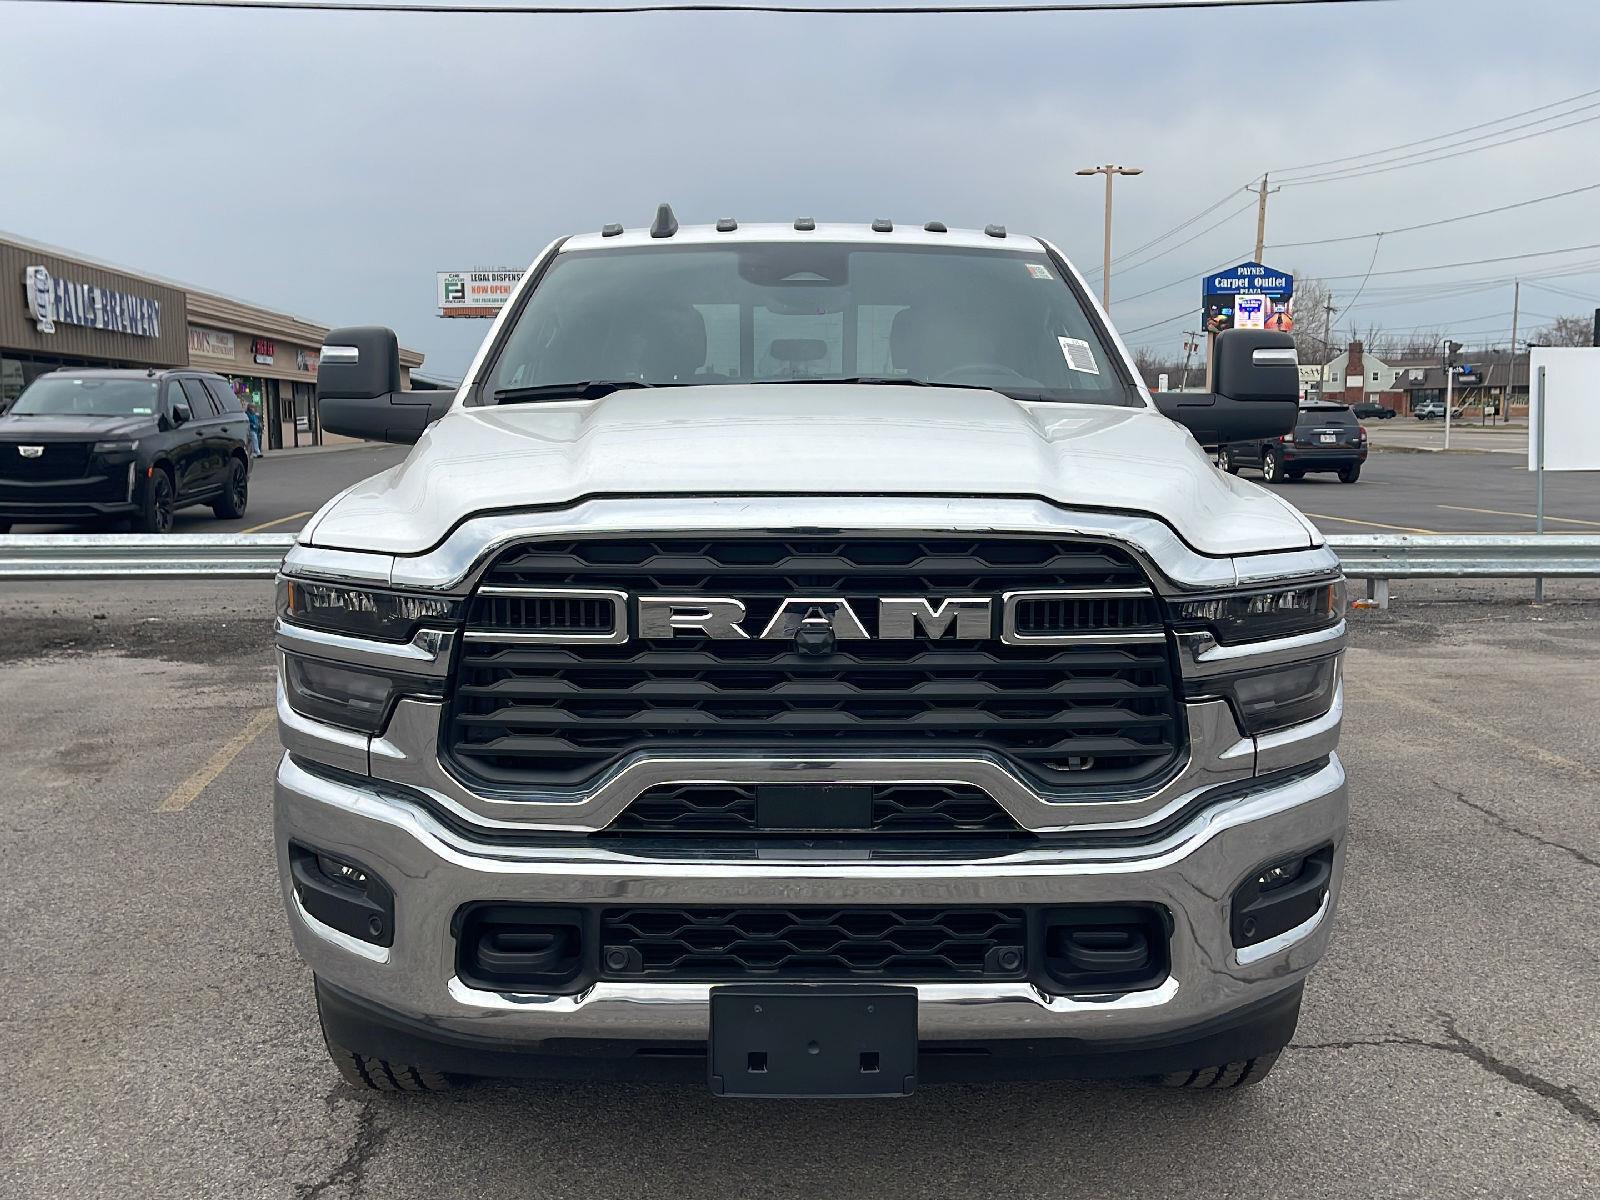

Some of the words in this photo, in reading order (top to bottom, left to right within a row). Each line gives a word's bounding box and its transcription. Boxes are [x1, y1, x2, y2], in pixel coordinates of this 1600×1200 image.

[1238, 267, 1264, 275] PAYNES
[471, 273, 490, 282] LEGAL
[1215, 277, 1249, 288] Carpet
[1254, 277, 1286, 287] Outlet
[471, 285, 488, 294] NOW
[489, 285, 511, 294] OPEN!
[53, 278, 97, 326] FALLS
[99, 287, 159, 337] BREWERY
[638, 596, 992, 640] RAM
